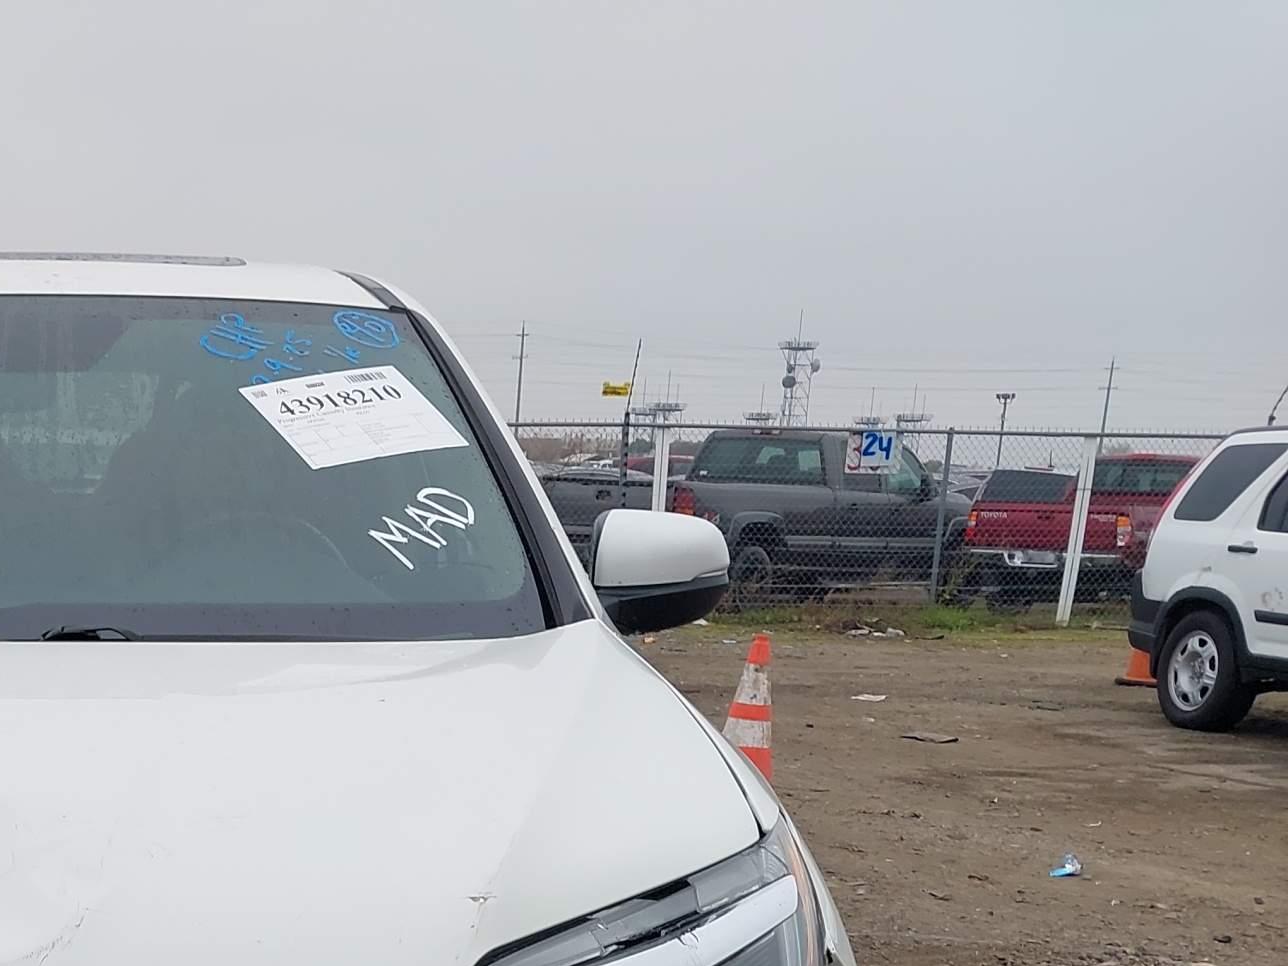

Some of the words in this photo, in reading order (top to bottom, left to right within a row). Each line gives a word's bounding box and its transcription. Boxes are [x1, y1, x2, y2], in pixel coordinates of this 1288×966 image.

[279, 384, 402, 416] 43918210
[862, 433, 892, 460] 24
[368, 487, 474, 570] MAD
[980, 511, 1008, 519] TOYOTA
